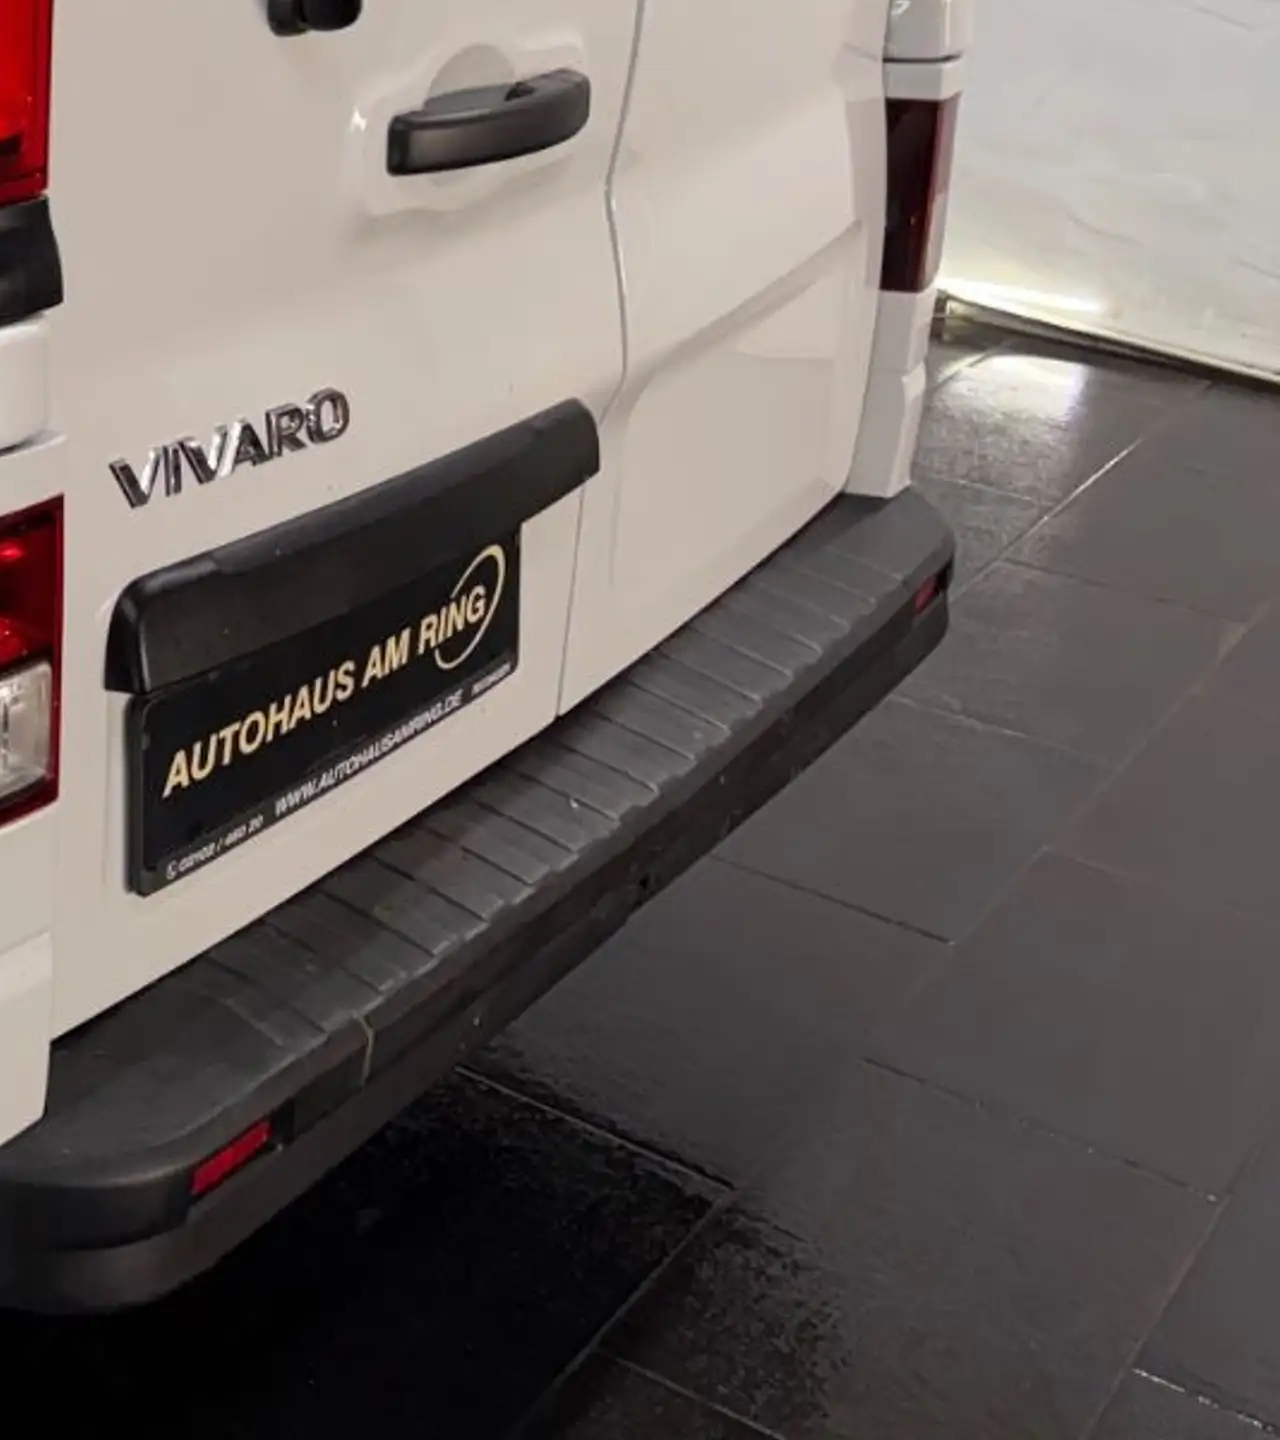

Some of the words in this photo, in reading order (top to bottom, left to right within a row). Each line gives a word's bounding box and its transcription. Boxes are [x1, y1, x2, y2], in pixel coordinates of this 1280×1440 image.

[108, 387, 350, 510] VIVARO
[162, 659, 356, 799] AUTOHAUS
[361, 627, 411, 688] AM
[418, 584, 487, 655] RING
